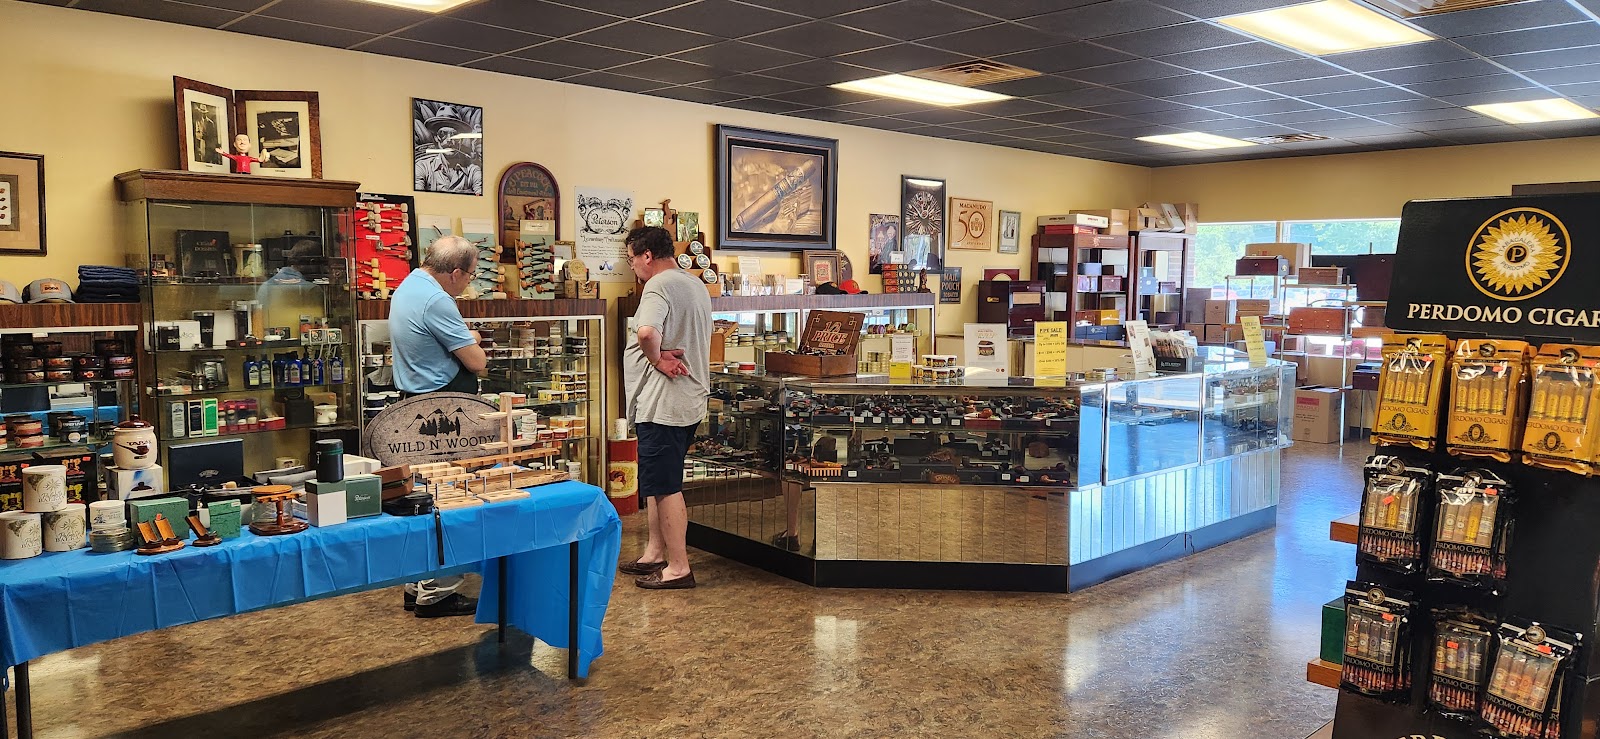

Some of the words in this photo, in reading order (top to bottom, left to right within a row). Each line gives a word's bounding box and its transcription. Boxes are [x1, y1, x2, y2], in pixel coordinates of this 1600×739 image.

[591, 213, 618, 226] Peterson
[957, 210, 985, 242] 50
[1499, 237, 1537, 255] TABACALERA
[1510, 246, 1525, 262] P
[1500, 260, 1531, 271] PERDOMO
[943, 273, 958, 282] MAIL
[1407, 303, 1523, 324] PERDOMO
[811, 330, 848, 344] PRICE
[1484, 416, 1509, 426] CIGARS
[387, 441, 425, 454] WILD
[445, 435, 496, 449] WOODY
[1390, 531, 1414, 541] CIGARS
[1466, 545, 1491, 556] CIGARS
[1370, 662, 1394, 674] CIGARS
[1516, 705, 1543, 720] CIGARS
